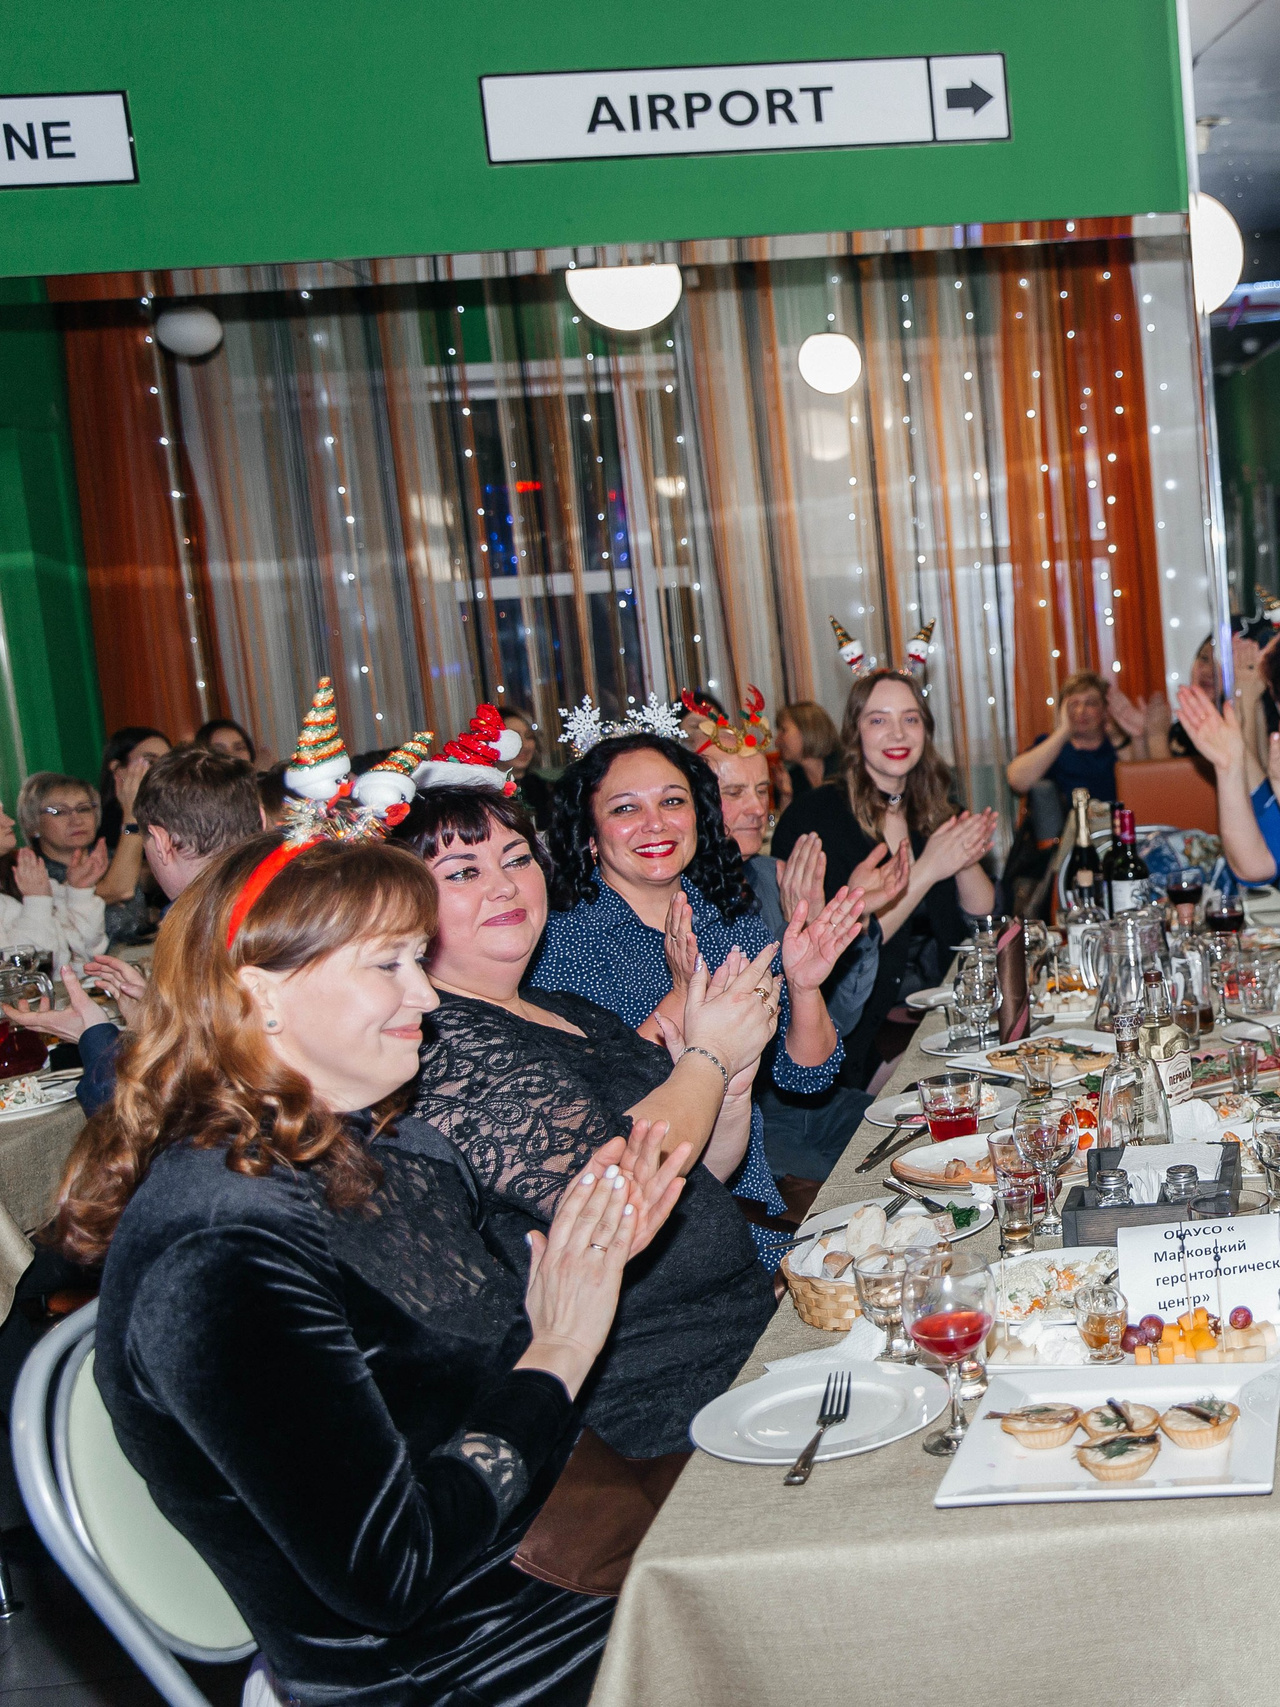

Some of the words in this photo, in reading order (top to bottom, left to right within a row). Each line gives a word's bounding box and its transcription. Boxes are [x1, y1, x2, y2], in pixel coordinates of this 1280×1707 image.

[586, 86, 834, 134] AIRPORT
[2, 121, 76, 161] NE
[1164, 1225, 1222, 1240] ОГАУСО
[1154, 1239, 1247, 1263] Марковский
